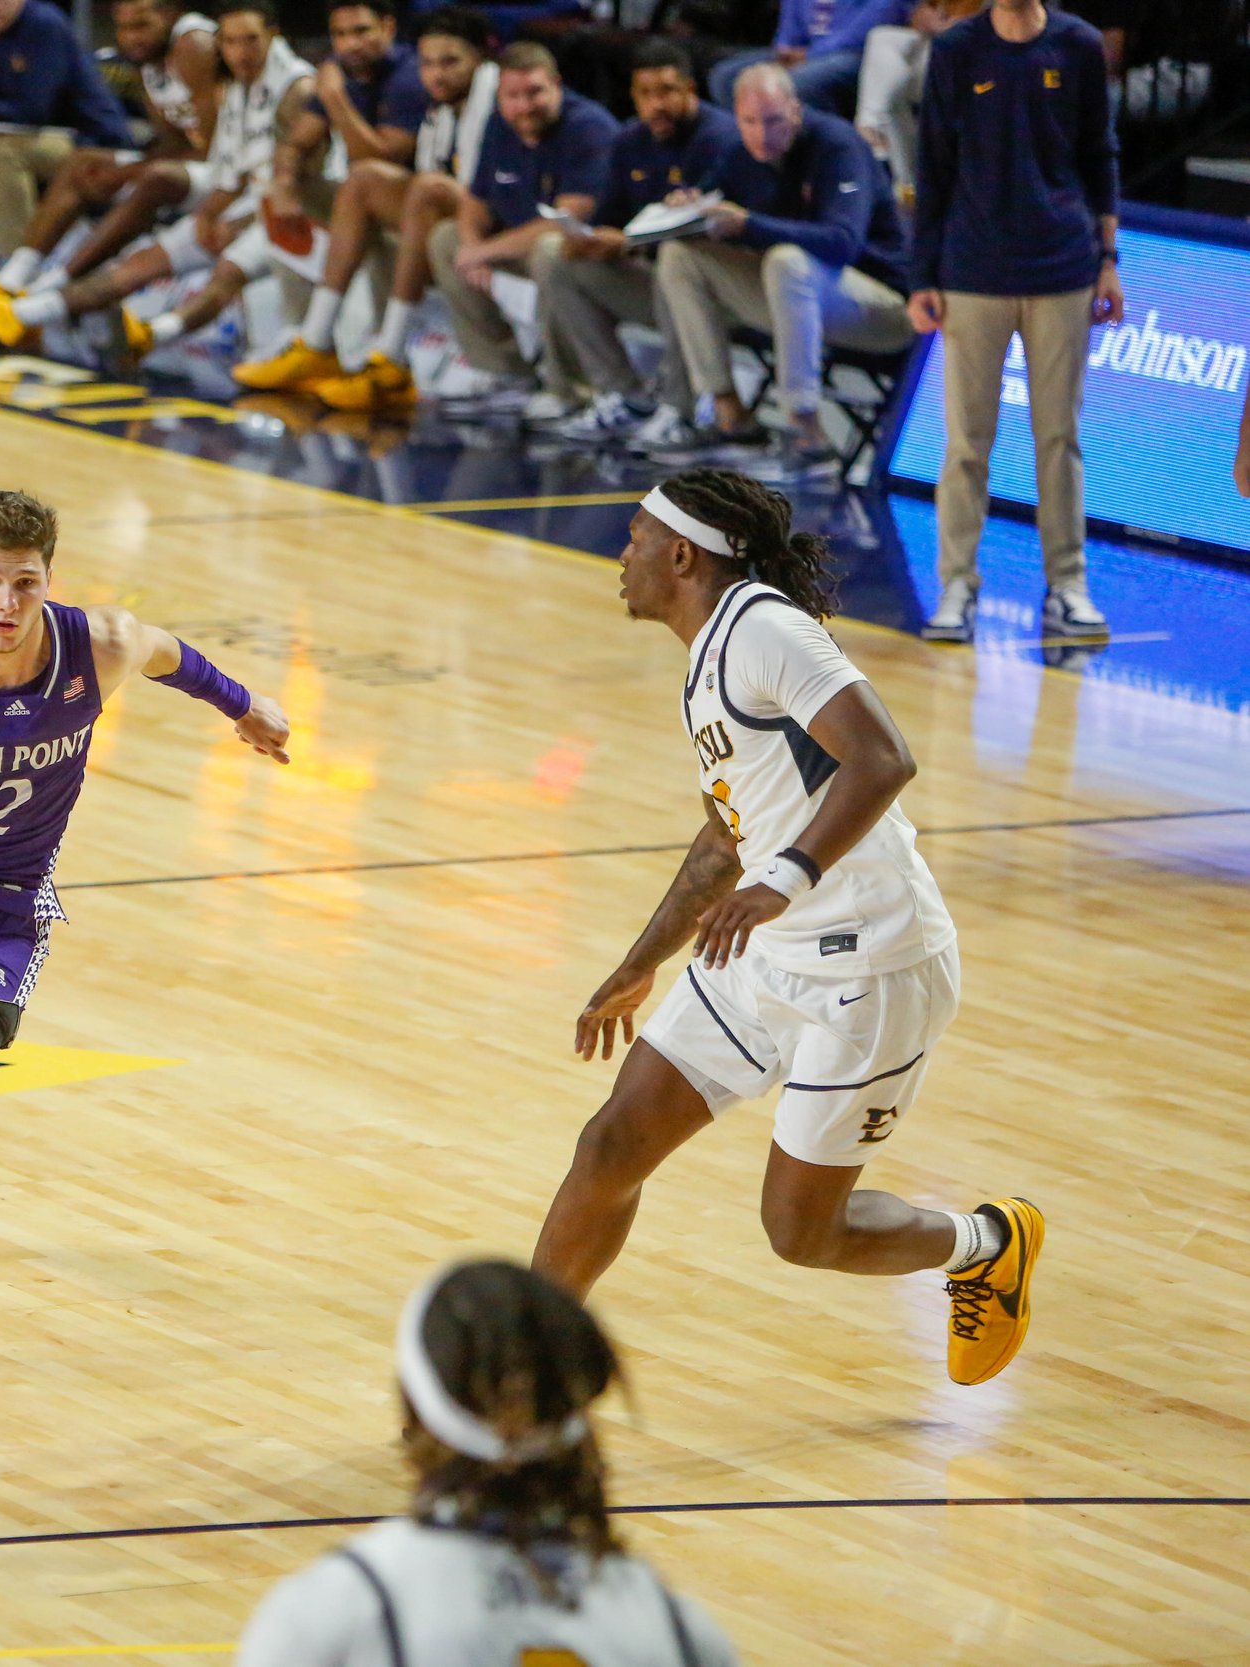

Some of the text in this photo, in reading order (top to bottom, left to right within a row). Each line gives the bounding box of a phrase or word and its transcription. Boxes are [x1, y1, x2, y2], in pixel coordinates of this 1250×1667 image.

[3, 709, 31, 717] adidas
[11, 723, 91, 772] POINT
[694, 720, 735, 773] TSU
[858, 1105, 899, 1144] E
